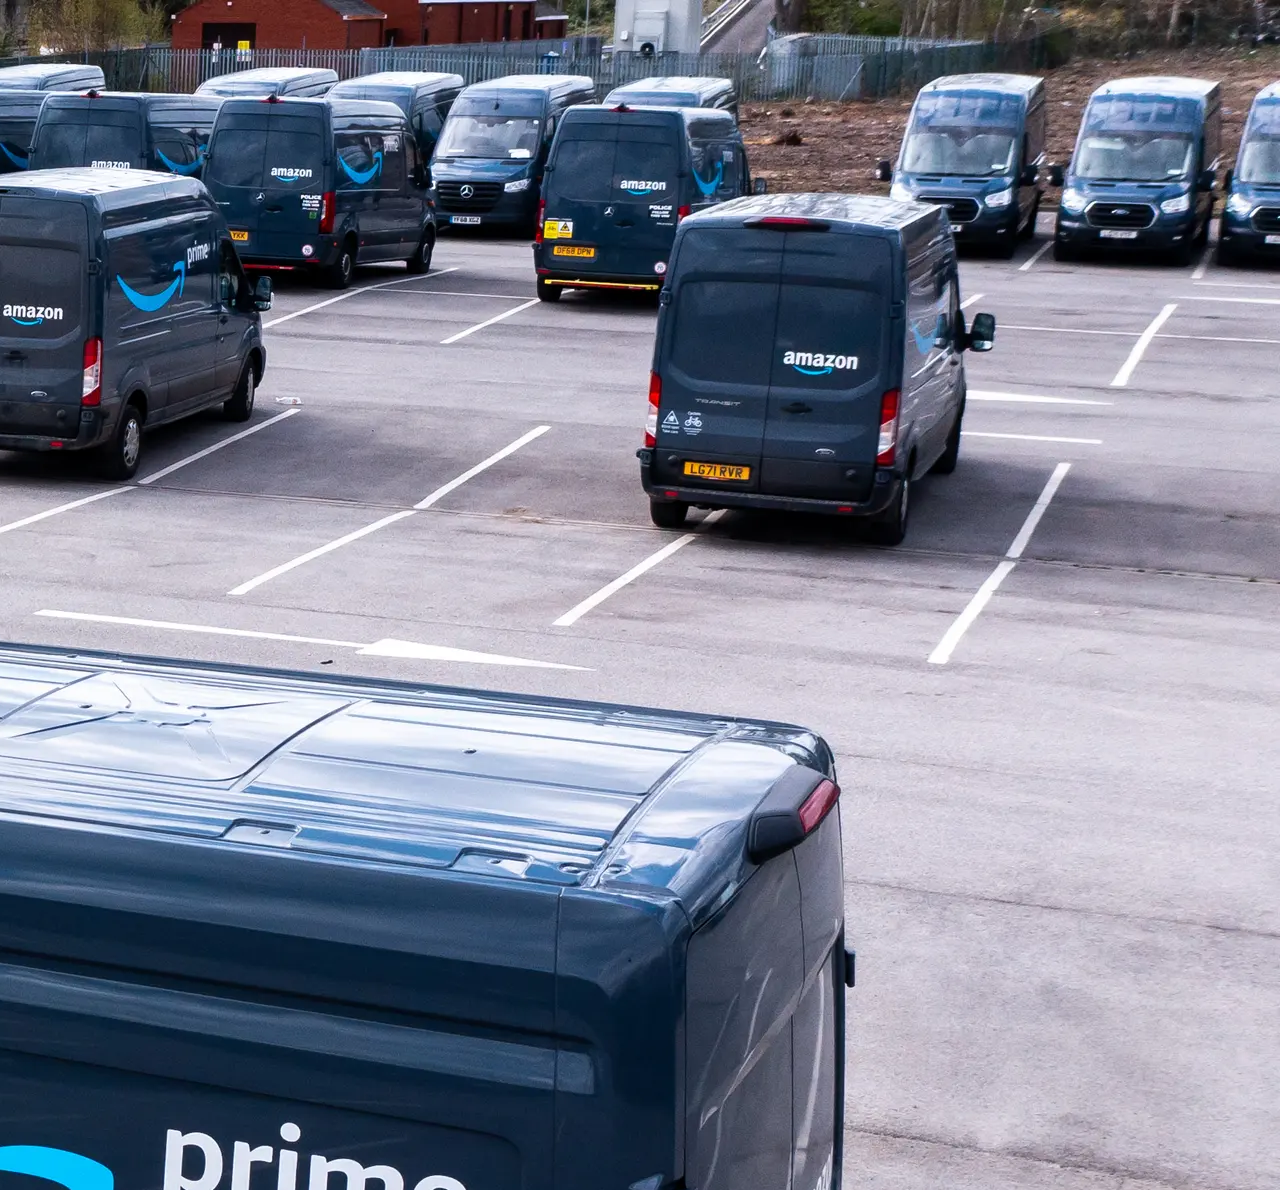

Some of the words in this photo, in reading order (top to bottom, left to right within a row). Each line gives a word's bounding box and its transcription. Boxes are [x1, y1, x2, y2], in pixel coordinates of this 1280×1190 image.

[91, 160, 130, 169] amazon
[271, 167, 312, 177] amazon
[620, 179, 666, 191] amazon
[187, 240, 208, 269] prime
[2, 304, 64, 320] amazon
[783, 350, 859, 370] amazon
[690, 463, 717, 475] LG71
[719, 466, 744, 478] RVR
